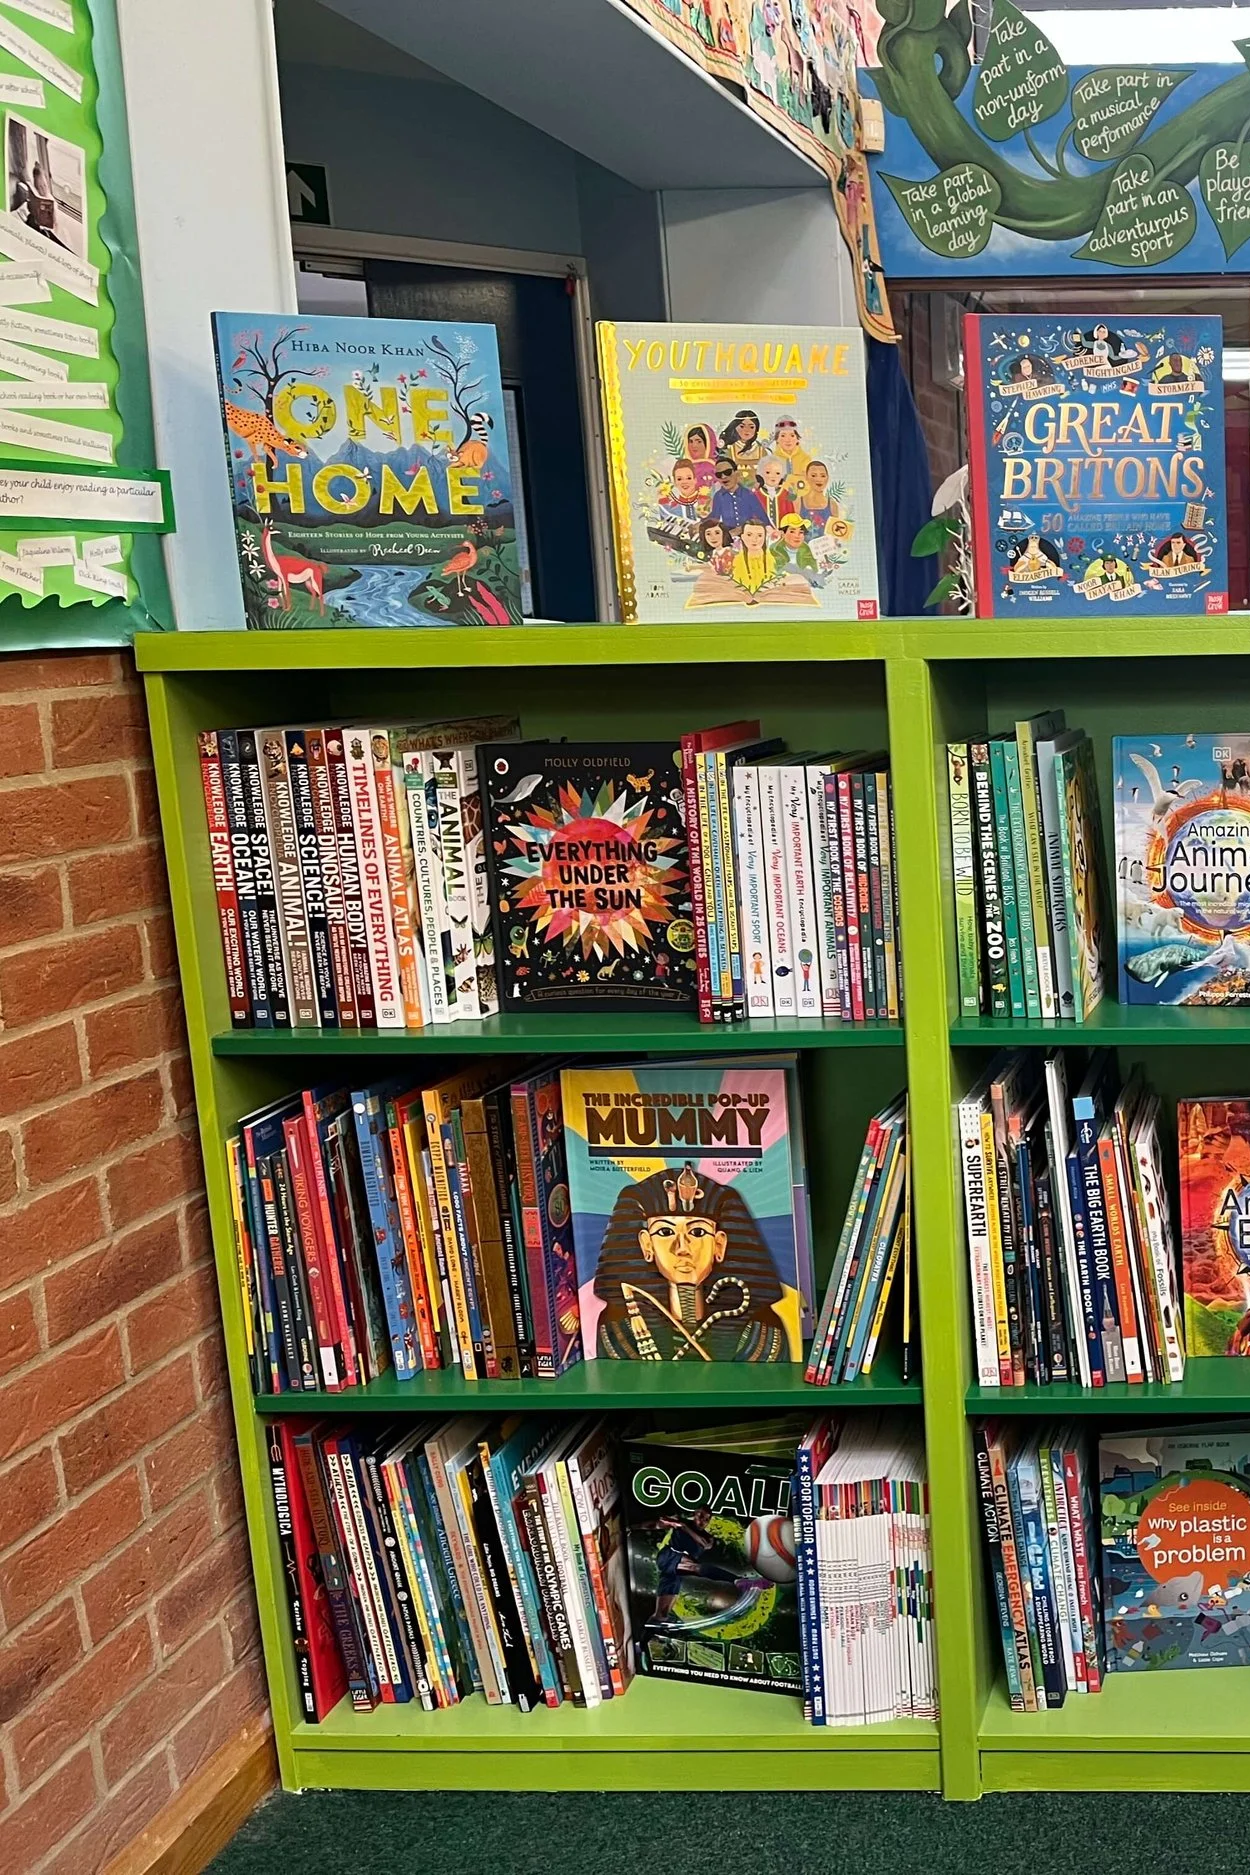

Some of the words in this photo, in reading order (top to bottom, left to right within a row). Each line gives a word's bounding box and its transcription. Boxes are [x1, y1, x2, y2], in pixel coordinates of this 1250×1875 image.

[622, 339, 850, 375] YOUTHQUAKE
[1065, 355, 1104, 369] FLORENCE
[1086, 360, 1141, 376] NIGHTINGALE
[1156, 382, 1196, 393] STORMZY
[272, 382, 456, 445] ONE
[1024, 402, 1184, 457] GREAT
[10, 480, 29, 490] your
[31, 479, 52, 488] child
[53, 483, 74, 493] enjoy
[76, 483, 107, 496] reading
[117, 487, 155, 496] particular
[250, 463, 485, 515] HOME
[1000, 452, 1205, 513] BRITONS
[545, 758, 577, 768] MOLLY
[583, 758, 630, 767] OLDFIELD
[1215, 750, 1229, 758] DK
[352, 762, 376, 859] TIMELINES
[209, 832, 233, 891] EARTH!
[231, 834, 256, 900] OCEAN!
[251, 834, 274, 895] SPACE!
[337, 834, 360, 895] HUMAN
[526, 840, 657, 863] EVERYTHING
[300, 835, 325, 918] SCIENCE!
[318, 835, 345, 925] DINOSAUR!
[364, 862, 379, 885] OF
[558, 864, 628, 885] UNDER
[279, 862, 308, 947] ANIMAL!
[384, 834, 402, 899] ANIMAL
[393, 904, 413, 956] ATLAS
[546, 888, 586, 910] THE
[594, 888, 642, 910] SUN
[346, 900, 367, 948] BODY!
[368, 888, 394, 1002] EVERYTHING
[582, 1092, 611, 1107] THE
[614, 1092, 704, 1107] INCREDIBLE
[708, 1093, 770, 1108] POP-UP
[585, 1107, 770, 1146] MUMMY
[1084, 1164, 1099, 1187] THE
[967, 1155, 986, 1237] SUPEREARTH
[1087, 1188, 1101, 1209] BIG
[1090, 1210, 1106, 1248] EARTH
[1094, 1249, 1110, 1280] BOOK
[271, 1468, 291, 1537] MYTHOLOGICA
[632, 1466, 791, 1518] GOAL!
[801, 1476, 814, 1543] SPORTOPEDIA
[1168, 1502, 1190, 1513] See
[1192, 1500, 1227, 1512] inside
[1148, 1517, 1177, 1531] Why
[1180, 1516, 1247, 1536] plastic
[1212, 1534, 1223, 1543] is
[994, 1483, 1012, 1541] CLIMATE
[1003, 1545, 1025, 1625] EMERGENCY
[1015, 1625, 1030, 1669] ATLAS
[1153, 1546, 1246, 1568] problem
